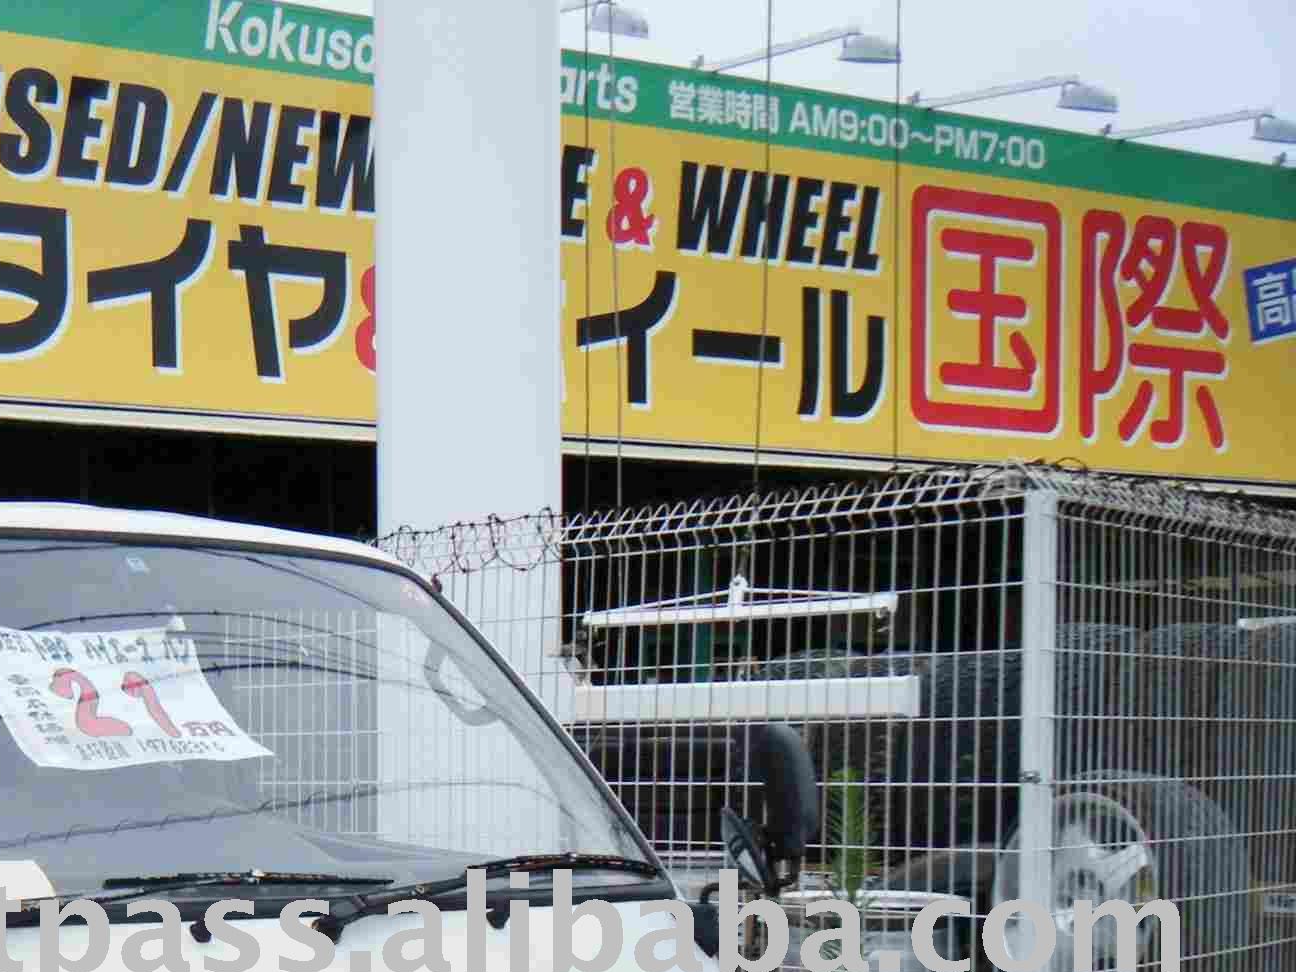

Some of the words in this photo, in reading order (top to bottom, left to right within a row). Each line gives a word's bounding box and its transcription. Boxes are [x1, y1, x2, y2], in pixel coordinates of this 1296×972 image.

[668, 79, 780, 135] 営業時間
[607, 167, 654, 248] &
[677, 160, 881, 272] WHEEL
[561, 270, 886, 420] イール
[911, 183, 1231, 449] 国際
